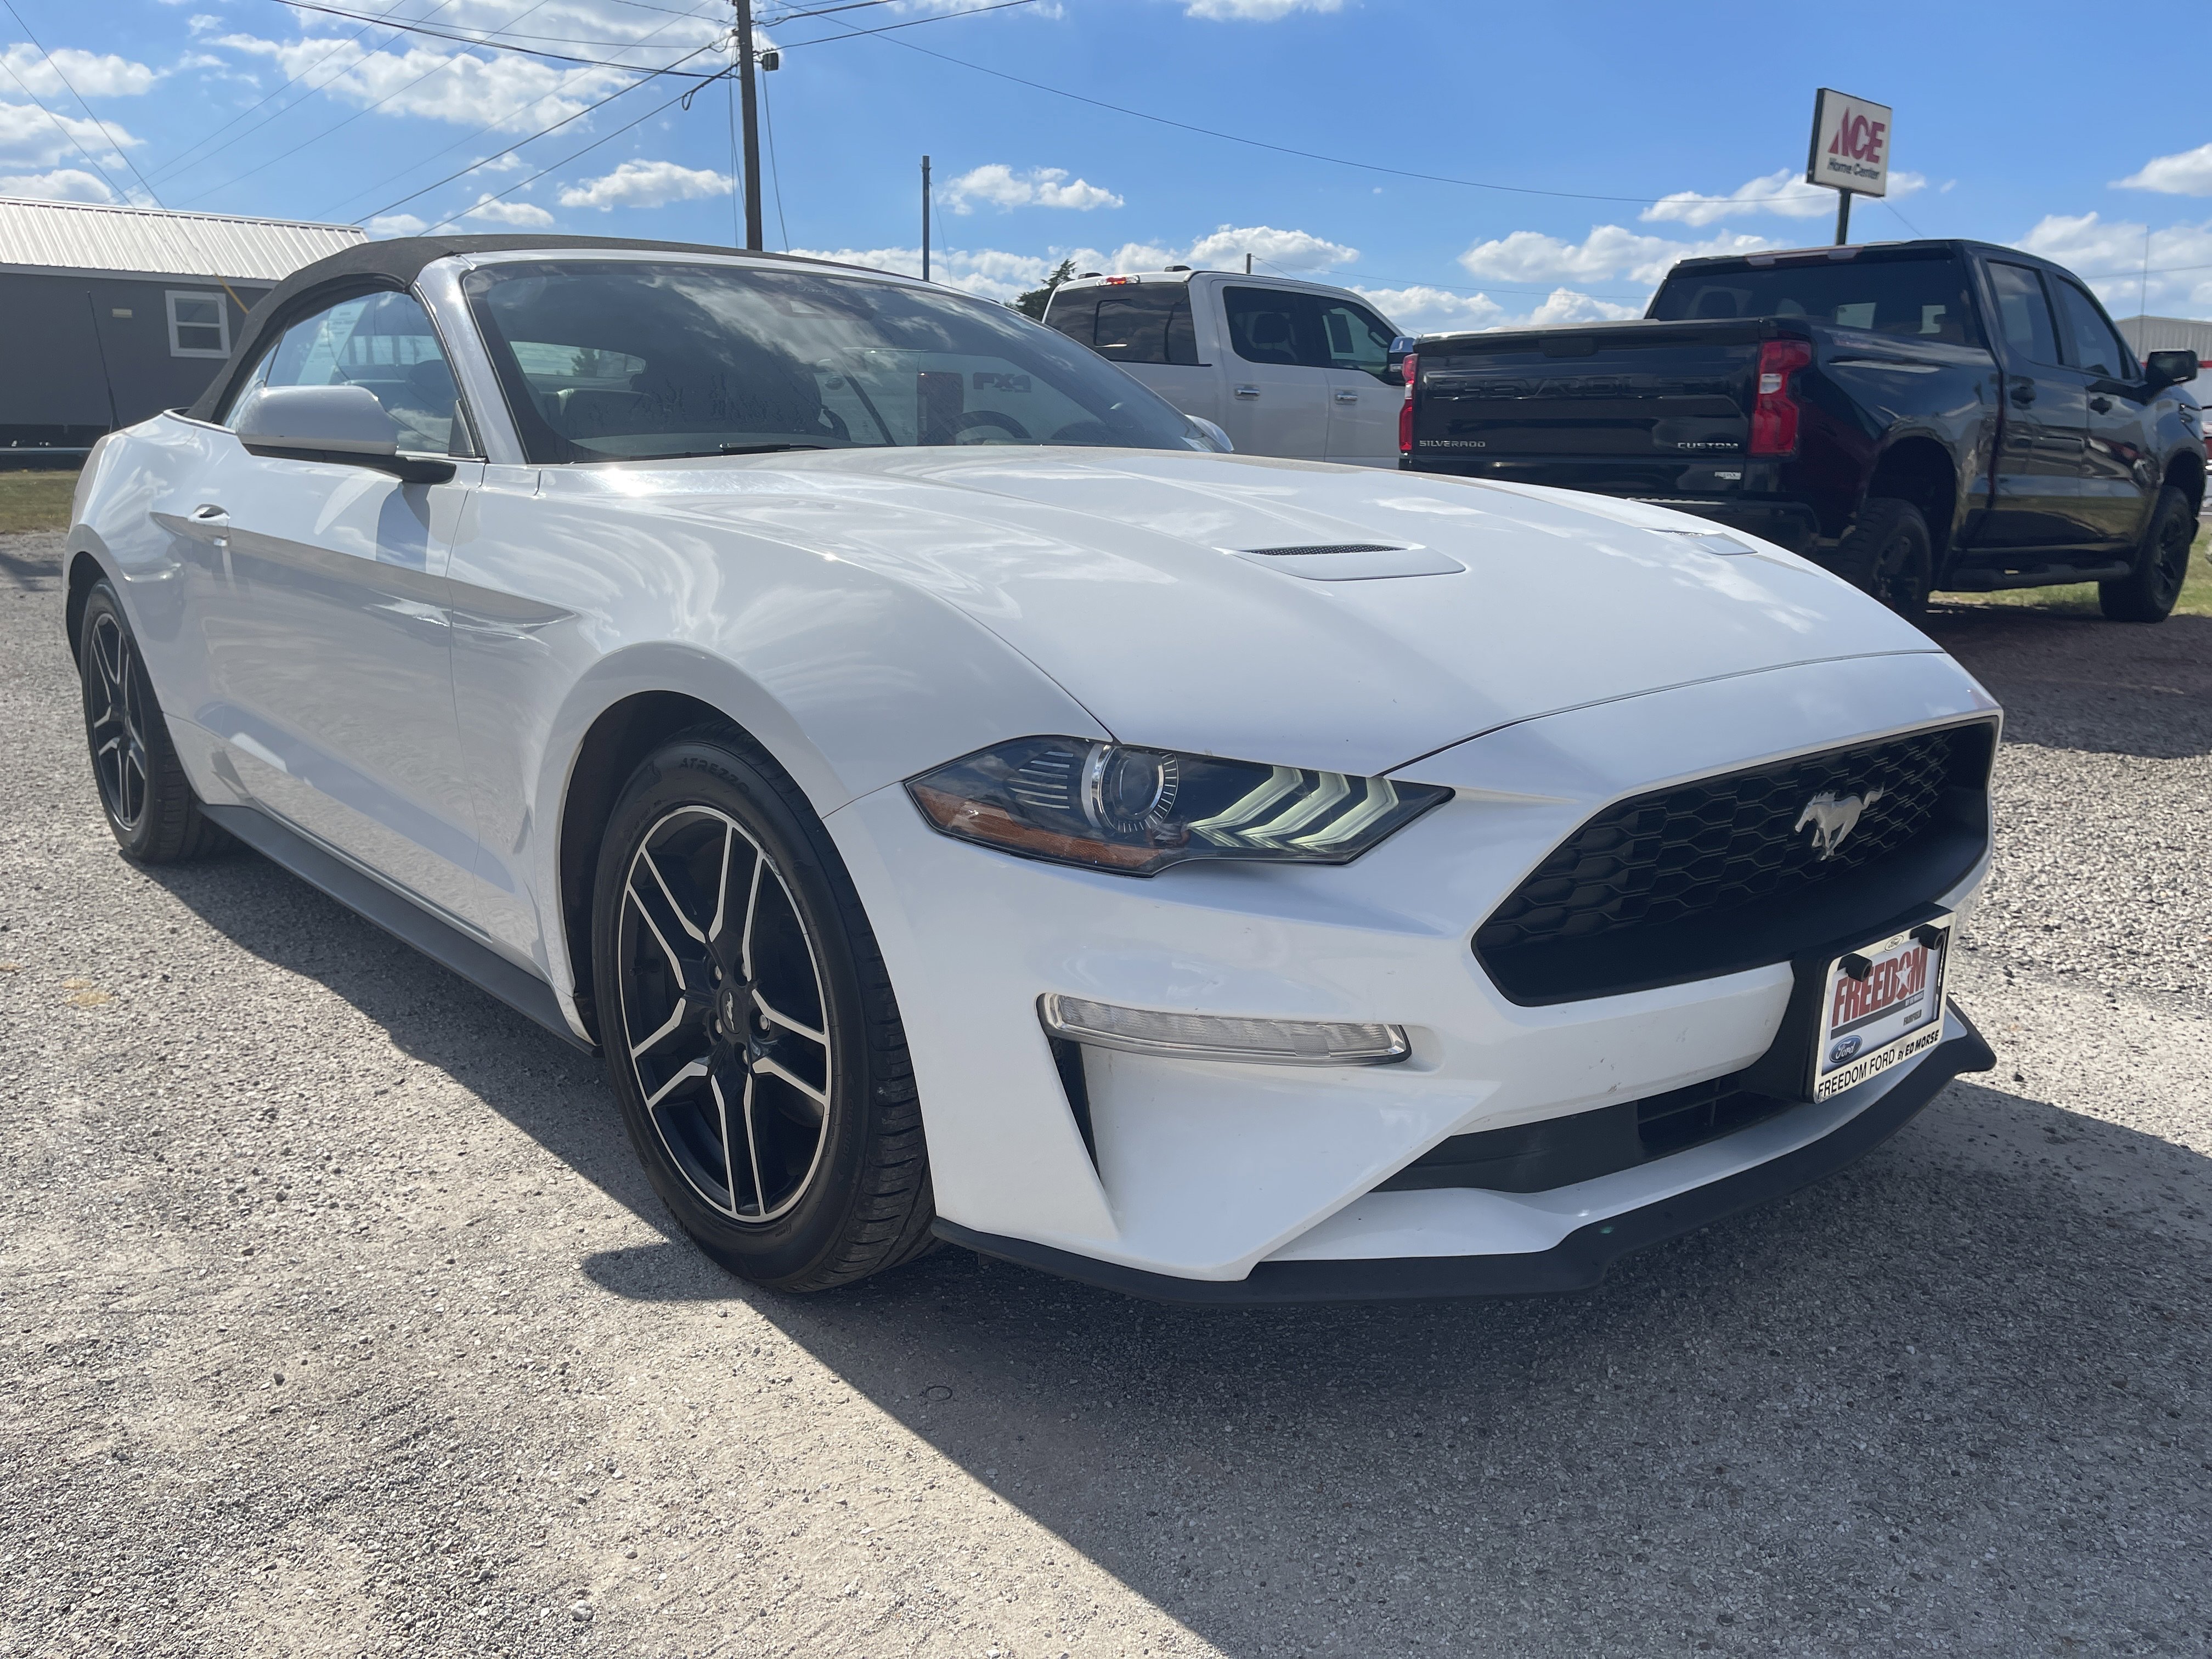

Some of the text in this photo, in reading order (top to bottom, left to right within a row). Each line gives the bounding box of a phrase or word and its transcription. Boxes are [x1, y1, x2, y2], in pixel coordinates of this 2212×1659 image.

[1828, 106, 1885, 163] ACE
[679, 757, 750, 794] ATREZZO
[1832, 947, 1928, 1028] FREEDOM
[1818, 1062, 1866, 1100] FREEDOM
[1869, 1048, 1895, 1075] FORD
[1905, 1042, 1914, 1057] ED
[1915, 1029, 1939, 1052] MORSE
[842, 1097, 855, 1164] OUTSIDE
